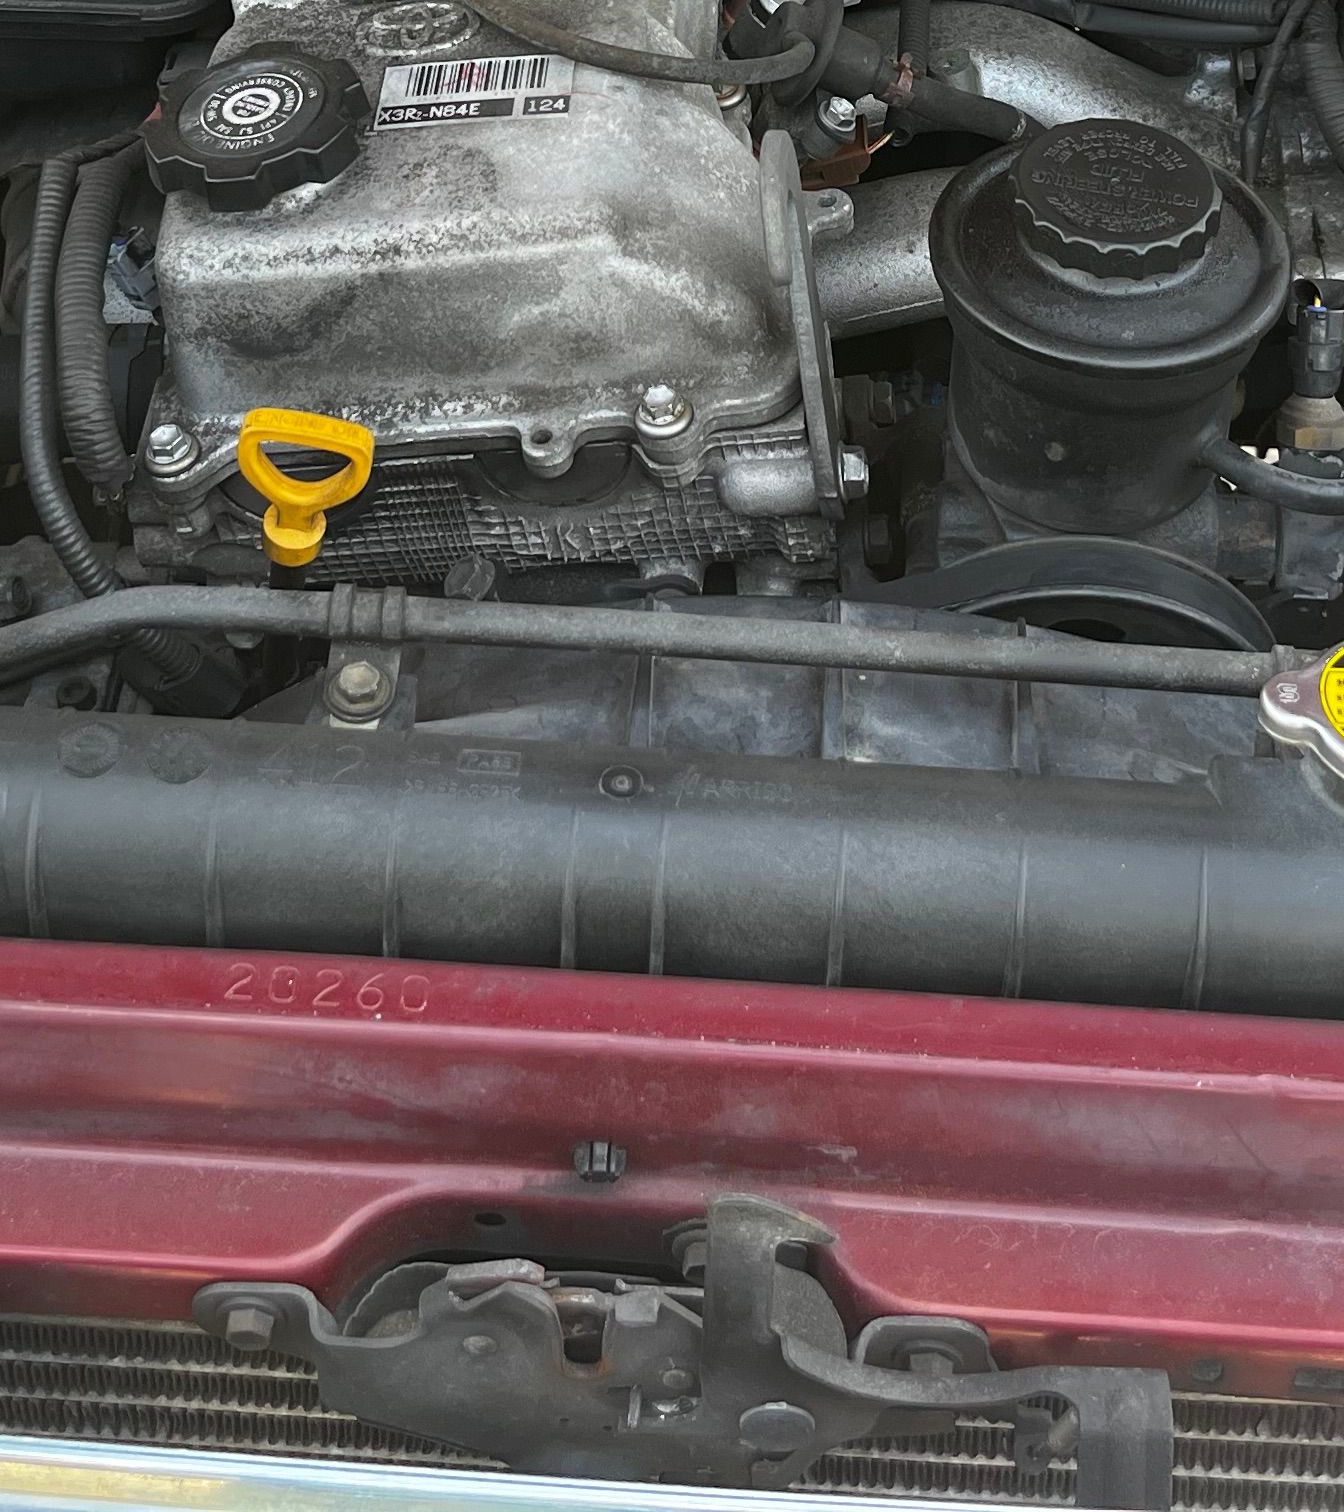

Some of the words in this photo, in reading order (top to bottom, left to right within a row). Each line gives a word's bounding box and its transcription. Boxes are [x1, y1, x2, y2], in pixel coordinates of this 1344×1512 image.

[528, 98, 566, 112] 124
[1031, 169, 1126, 196] STEERING
[1128, 186, 1199, 208] POWER
[224, 962, 430, 1013] 20260
